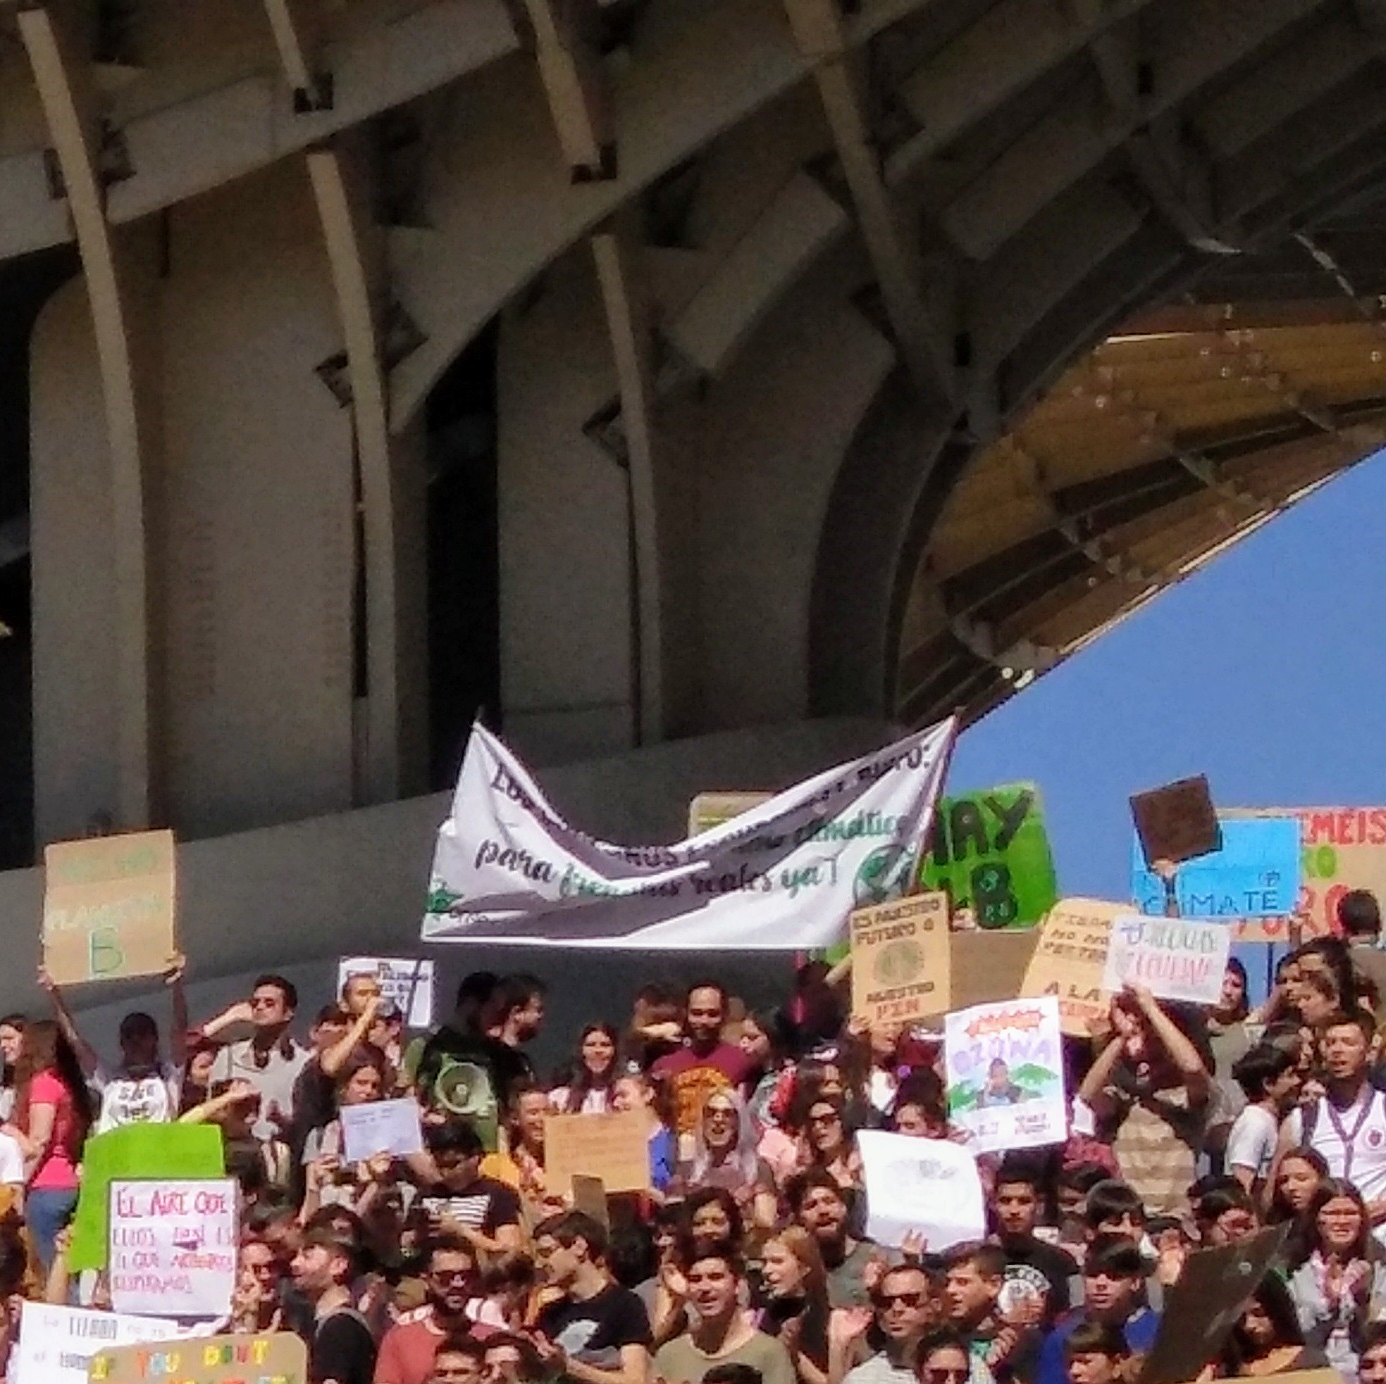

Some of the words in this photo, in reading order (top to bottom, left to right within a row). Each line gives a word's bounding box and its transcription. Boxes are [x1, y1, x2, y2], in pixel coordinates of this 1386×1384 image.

[857, 922, 916, 945] FUTURO
[90, 927, 124, 975] B
[877, 999, 919, 1020] FIN
[952, 1036, 1052, 1076] OZUNA
[137, 1350, 181, 1378] YOU
